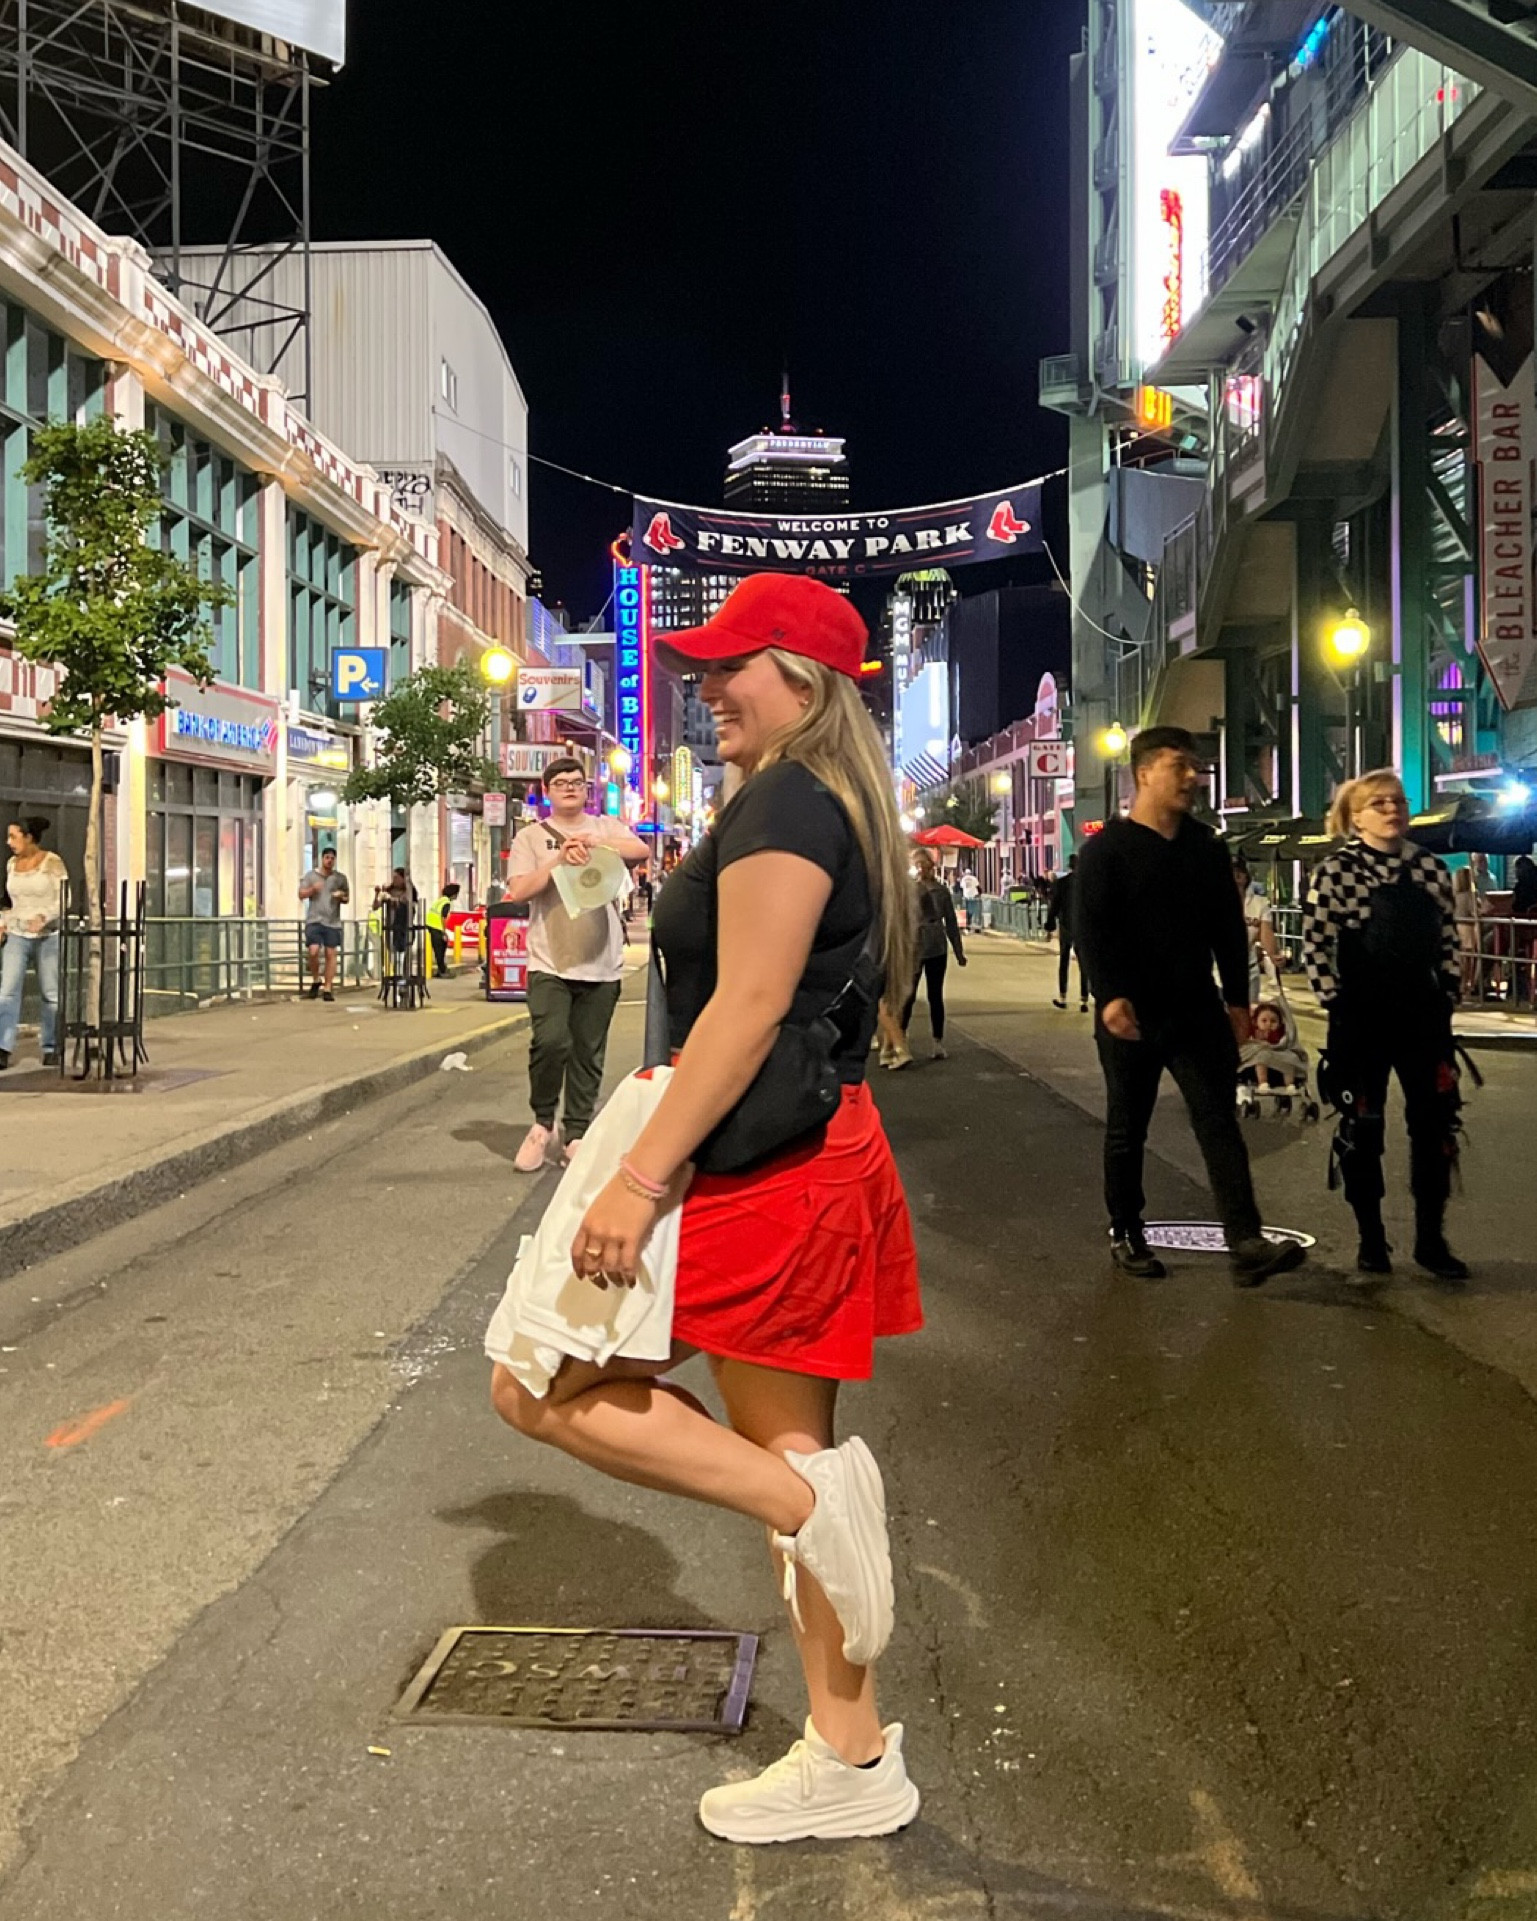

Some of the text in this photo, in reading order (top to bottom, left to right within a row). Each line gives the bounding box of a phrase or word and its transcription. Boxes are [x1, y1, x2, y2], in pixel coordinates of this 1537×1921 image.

[1492, 402, 1521, 462] BAR
[697, 521, 974, 560] FENWAY PARK
[777, 517, 890, 532] WELCOME TO
[805, 564, 867, 575] GATE C
[1493, 479, 1524, 640] BLEACHER
[620, 567, 639, 666] HOUSE
[895, 601, 910, 647] MGM
[338, 656, 367, 694] P
[519, 673, 580, 686] Souvenirs
[620, 674, 639, 688] of
[1036, 753, 1060, 774] C
